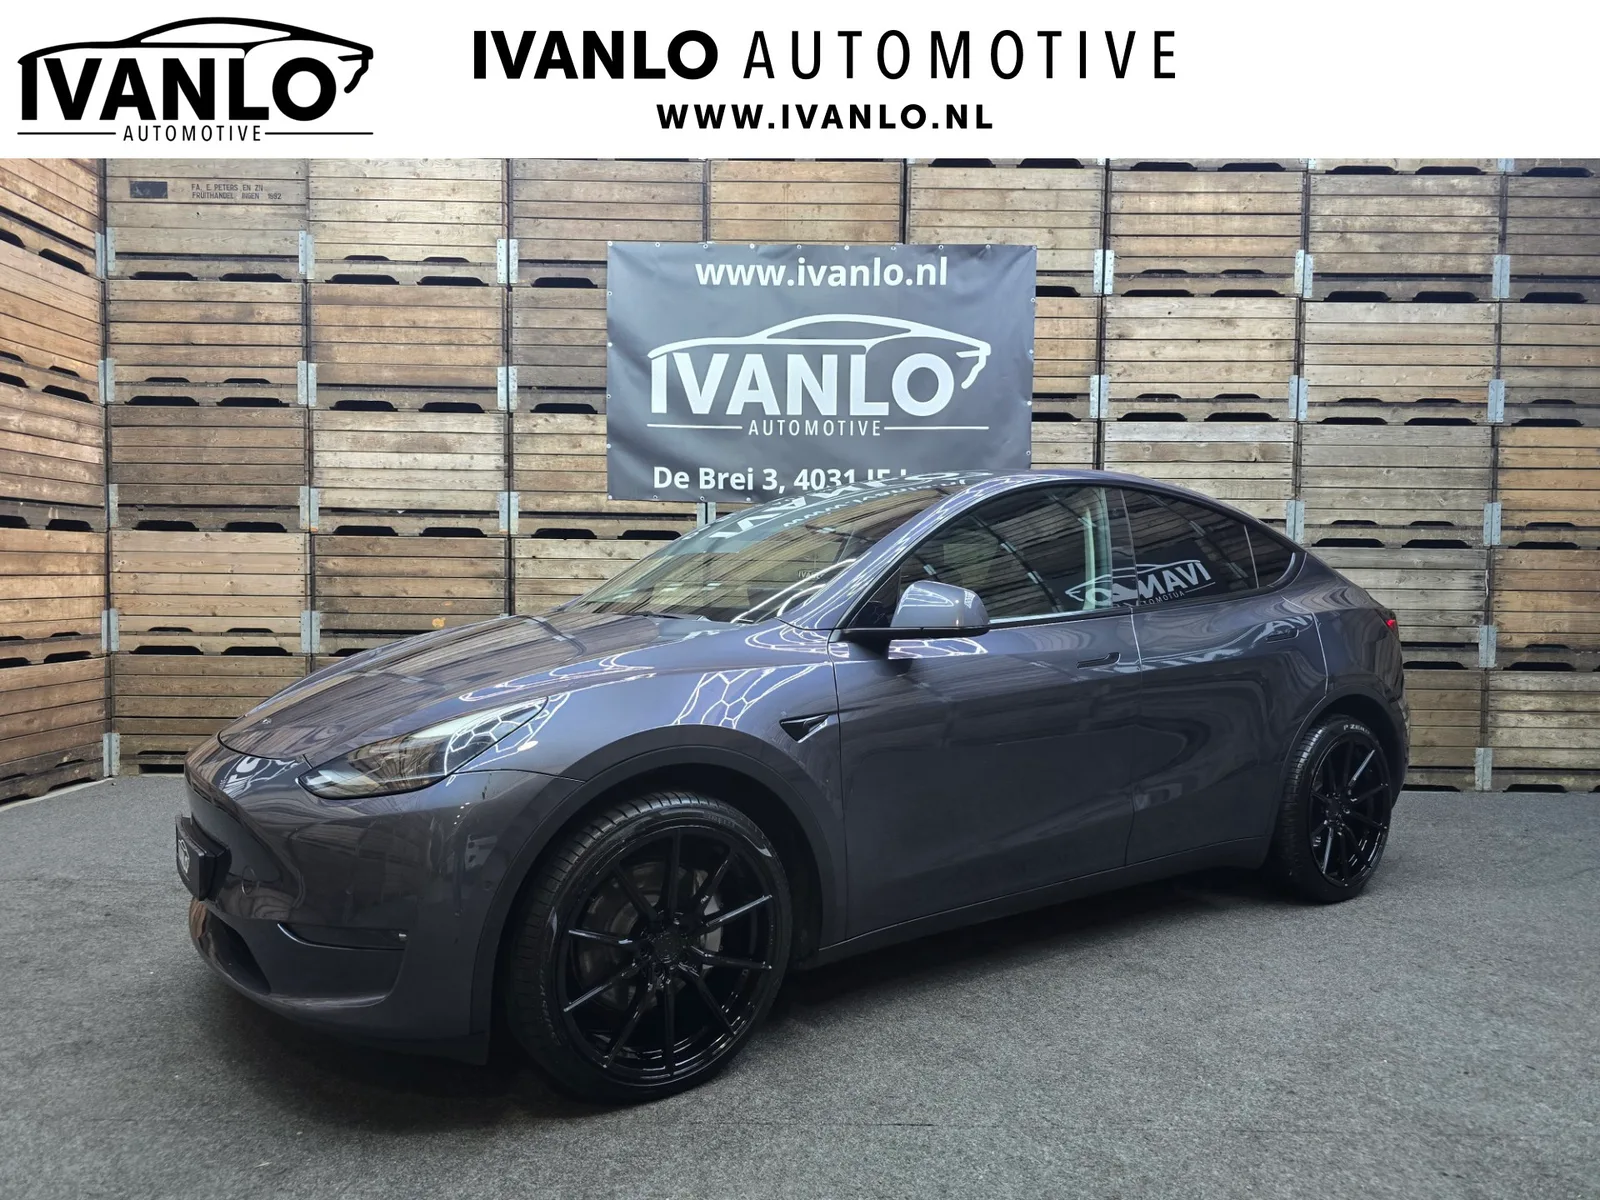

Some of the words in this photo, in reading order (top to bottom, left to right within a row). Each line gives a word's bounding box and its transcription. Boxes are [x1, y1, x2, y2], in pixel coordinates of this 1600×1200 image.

[695, 257, 948, 287] www.ivanlo.nl
[651, 353, 955, 417] IVANLO
[748, 419, 881, 437] AUTOMOTIVE
[653, 467, 690, 489] De
[699, 467, 754, 491] Brei
[762, 469, 786, 494] 3,
